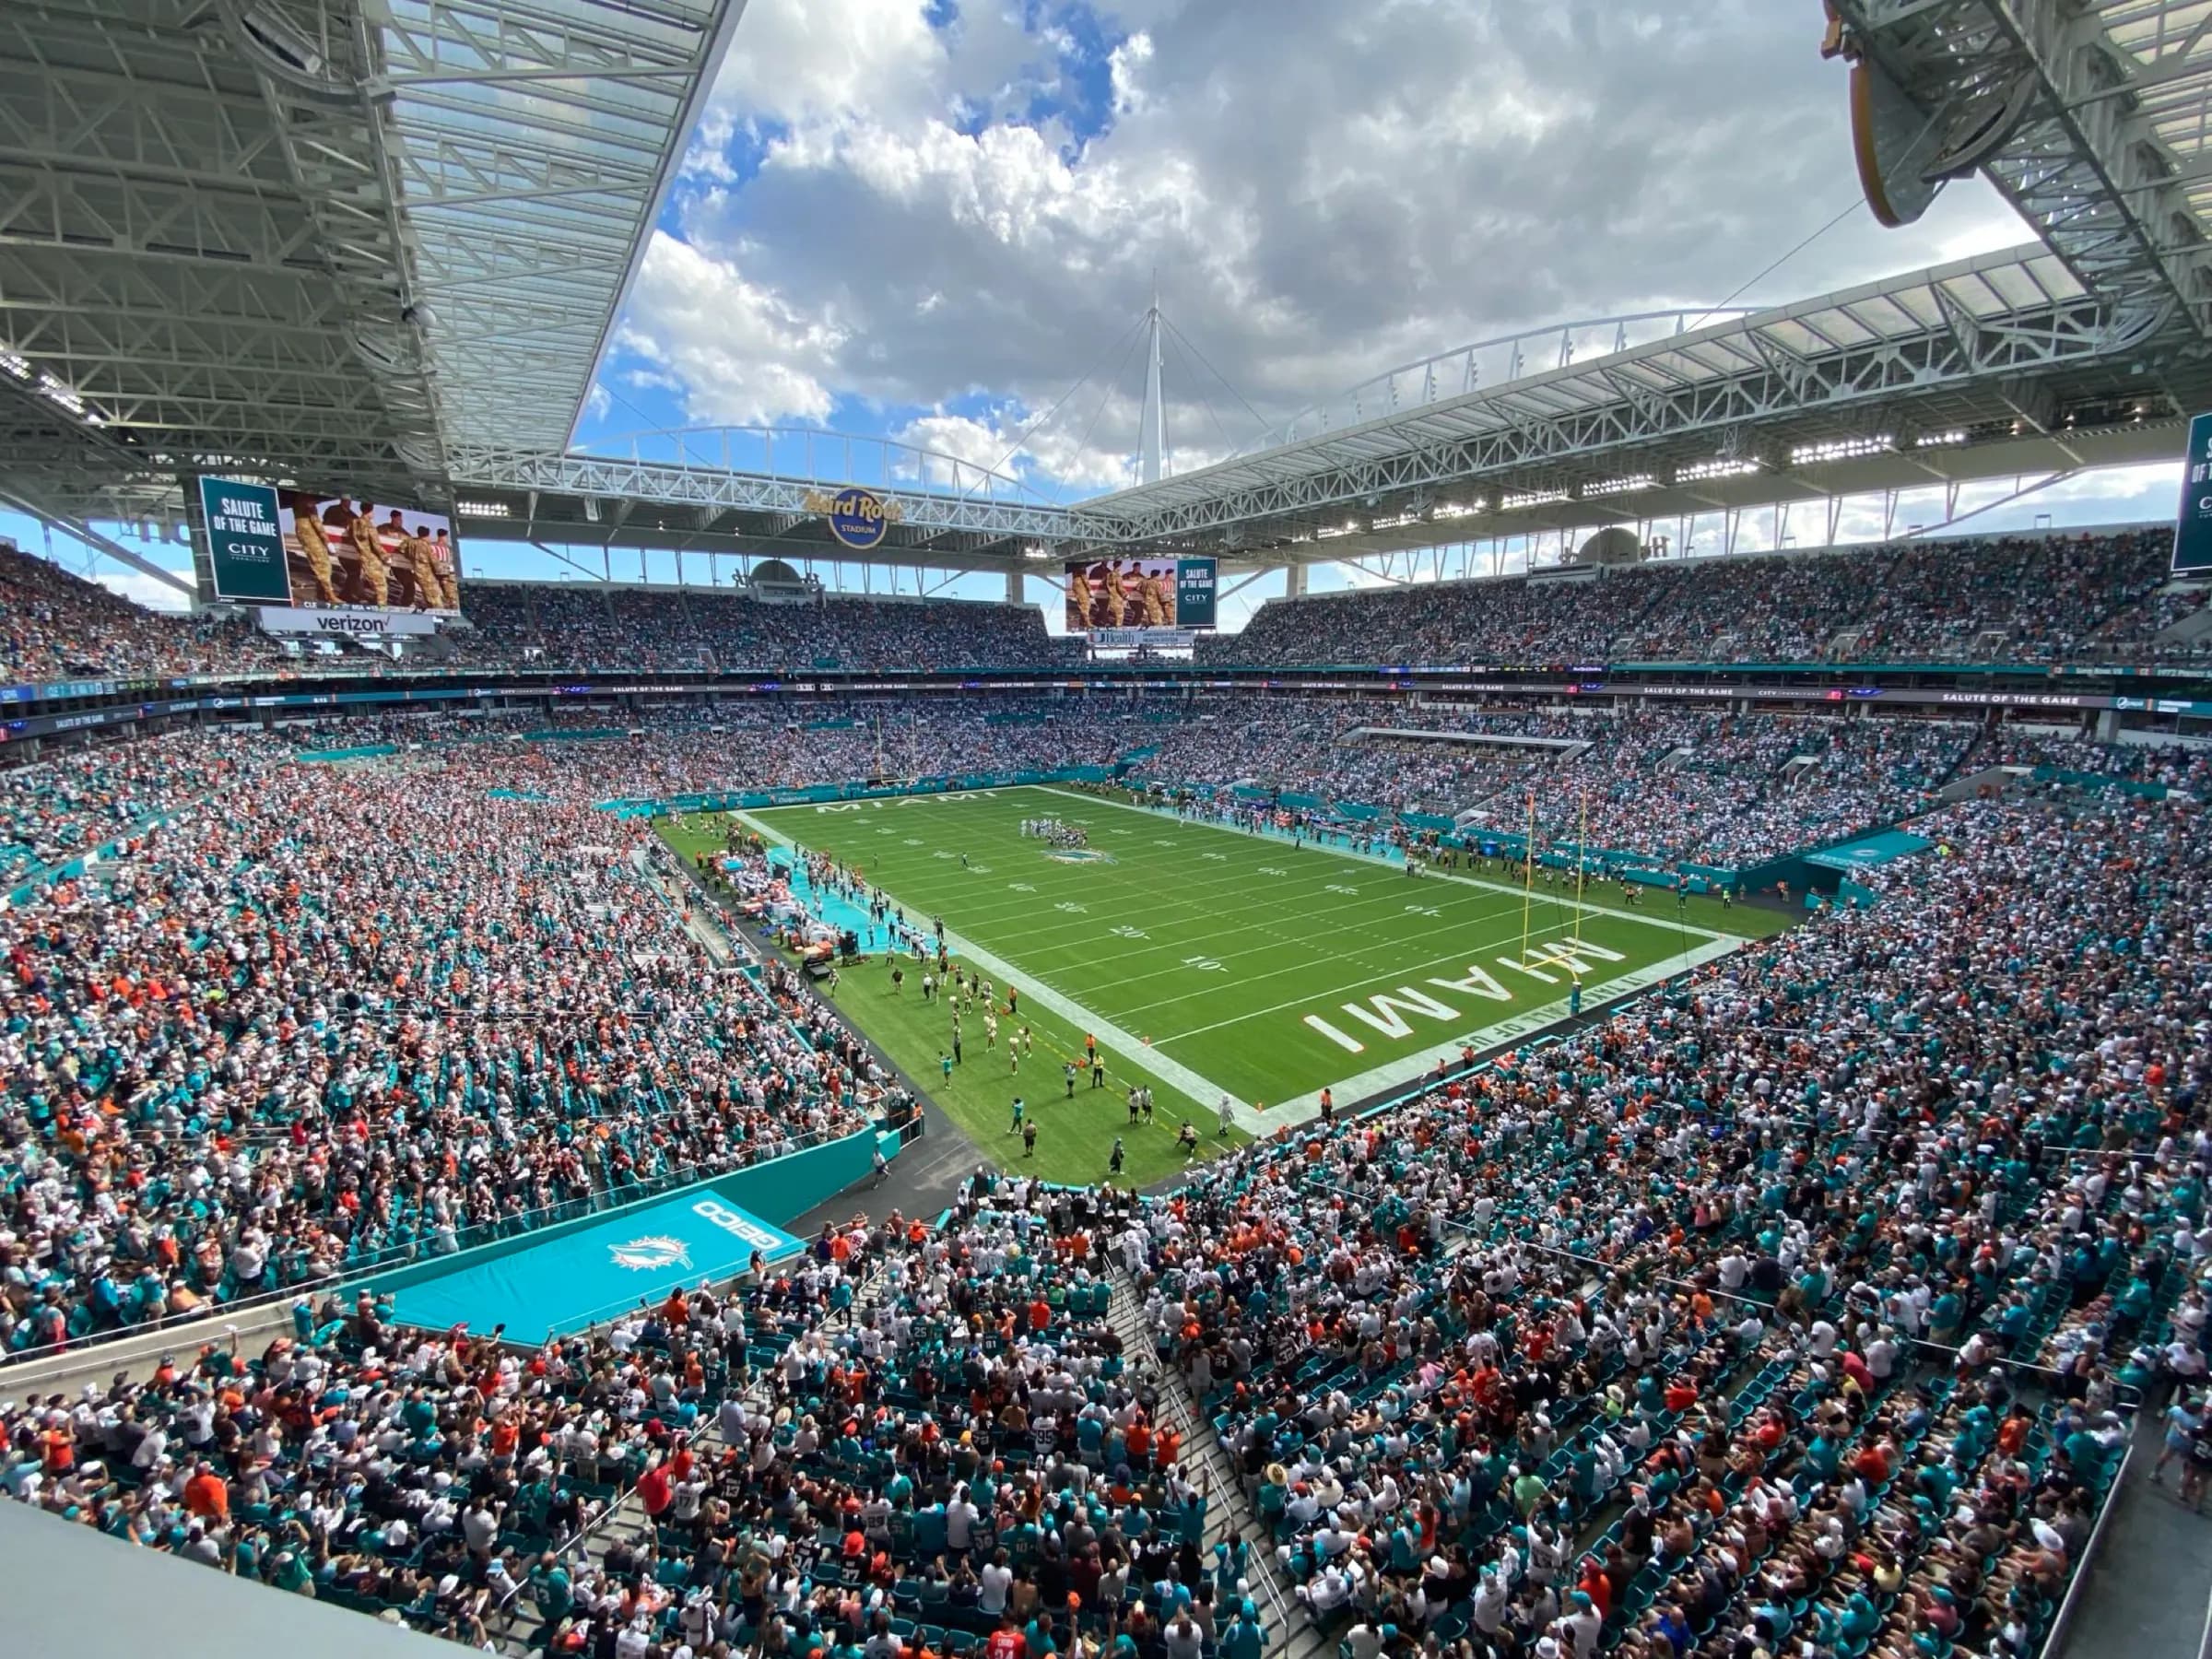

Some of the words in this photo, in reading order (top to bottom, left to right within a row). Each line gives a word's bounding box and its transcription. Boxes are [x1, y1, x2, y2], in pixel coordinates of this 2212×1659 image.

[221, 498, 263, 519] SALUTE
[214, 515, 227, 530] OF
[229, 517, 247, 534] THE
[249, 521, 277, 536] GAME
[841, 524, 877, 535] STADIUM
[229, 543, 269, 556] CITY
[1186, 569, 1207, 579] SALUTE
[1184, 594, 1207, 602] CITY
[317, 615, 384, 631] verizon
[816, 792, 998, 814] MIAMI
[1181, 956, 1222, 971] 10
[1303, 936, 1626, 1053] MIAMI
[1496, 1021, 1526, 1038] OF
[1455, 1035, 1495, 1050] US
[692, 1201, 782, 1249] GEICO
[914, 1327, 927, 1337] 25
[706, 1369, 717, 1380] 13
[1037, 1430, 1053, 1444] 95
[725, 1485, 739, 1497] 13
[678, 1496, 691, 1508] 17
[531, 1585, 550, 1605] 13
